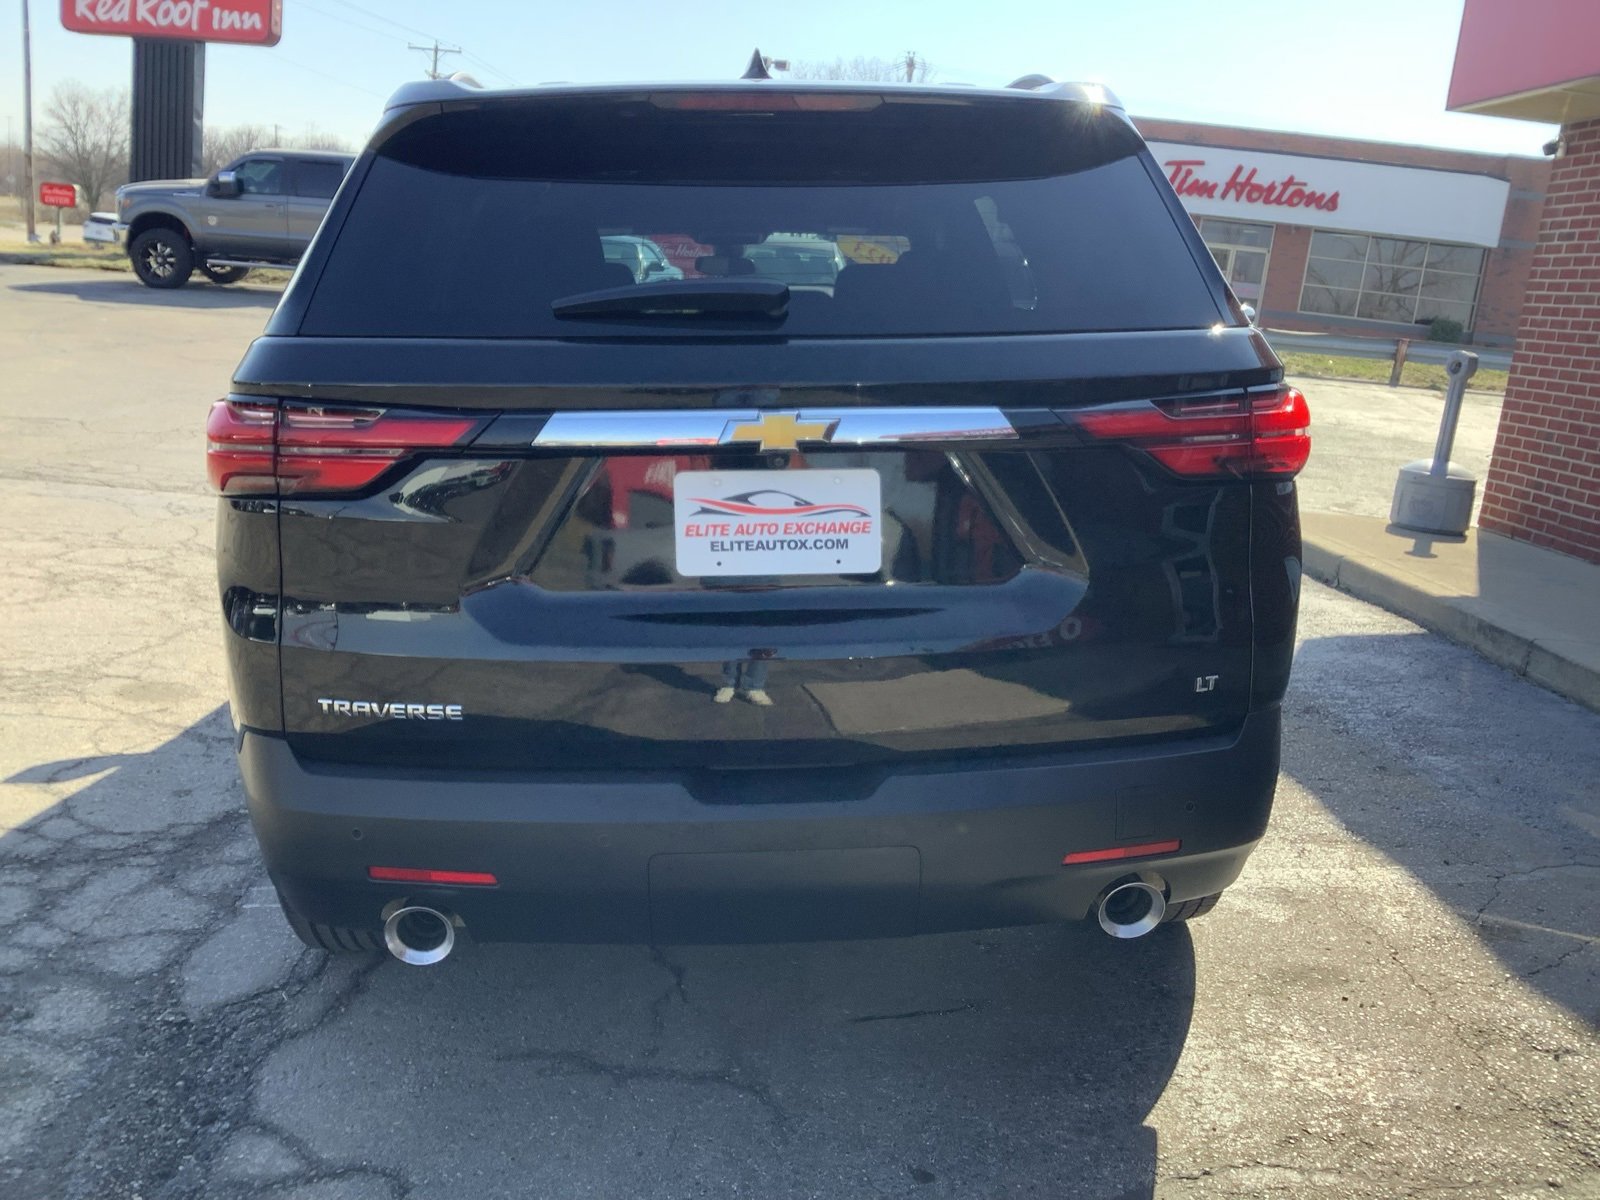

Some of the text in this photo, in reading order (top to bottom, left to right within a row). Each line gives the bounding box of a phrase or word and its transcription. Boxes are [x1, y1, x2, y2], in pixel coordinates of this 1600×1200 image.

[75, 0, 129, 22] Red
[136, 0, 209, 31] Roof
[1164, 160, 1340, 212] Tim Hortons
[685, 521, 872, 538] ELITE AUTO EXCHANGE
[710, 538, 849, 552] ELITEAUTOX.COM
[1195, 674, 1219, 692] LT
[317, 698, 463, 721] TRAVERSE
